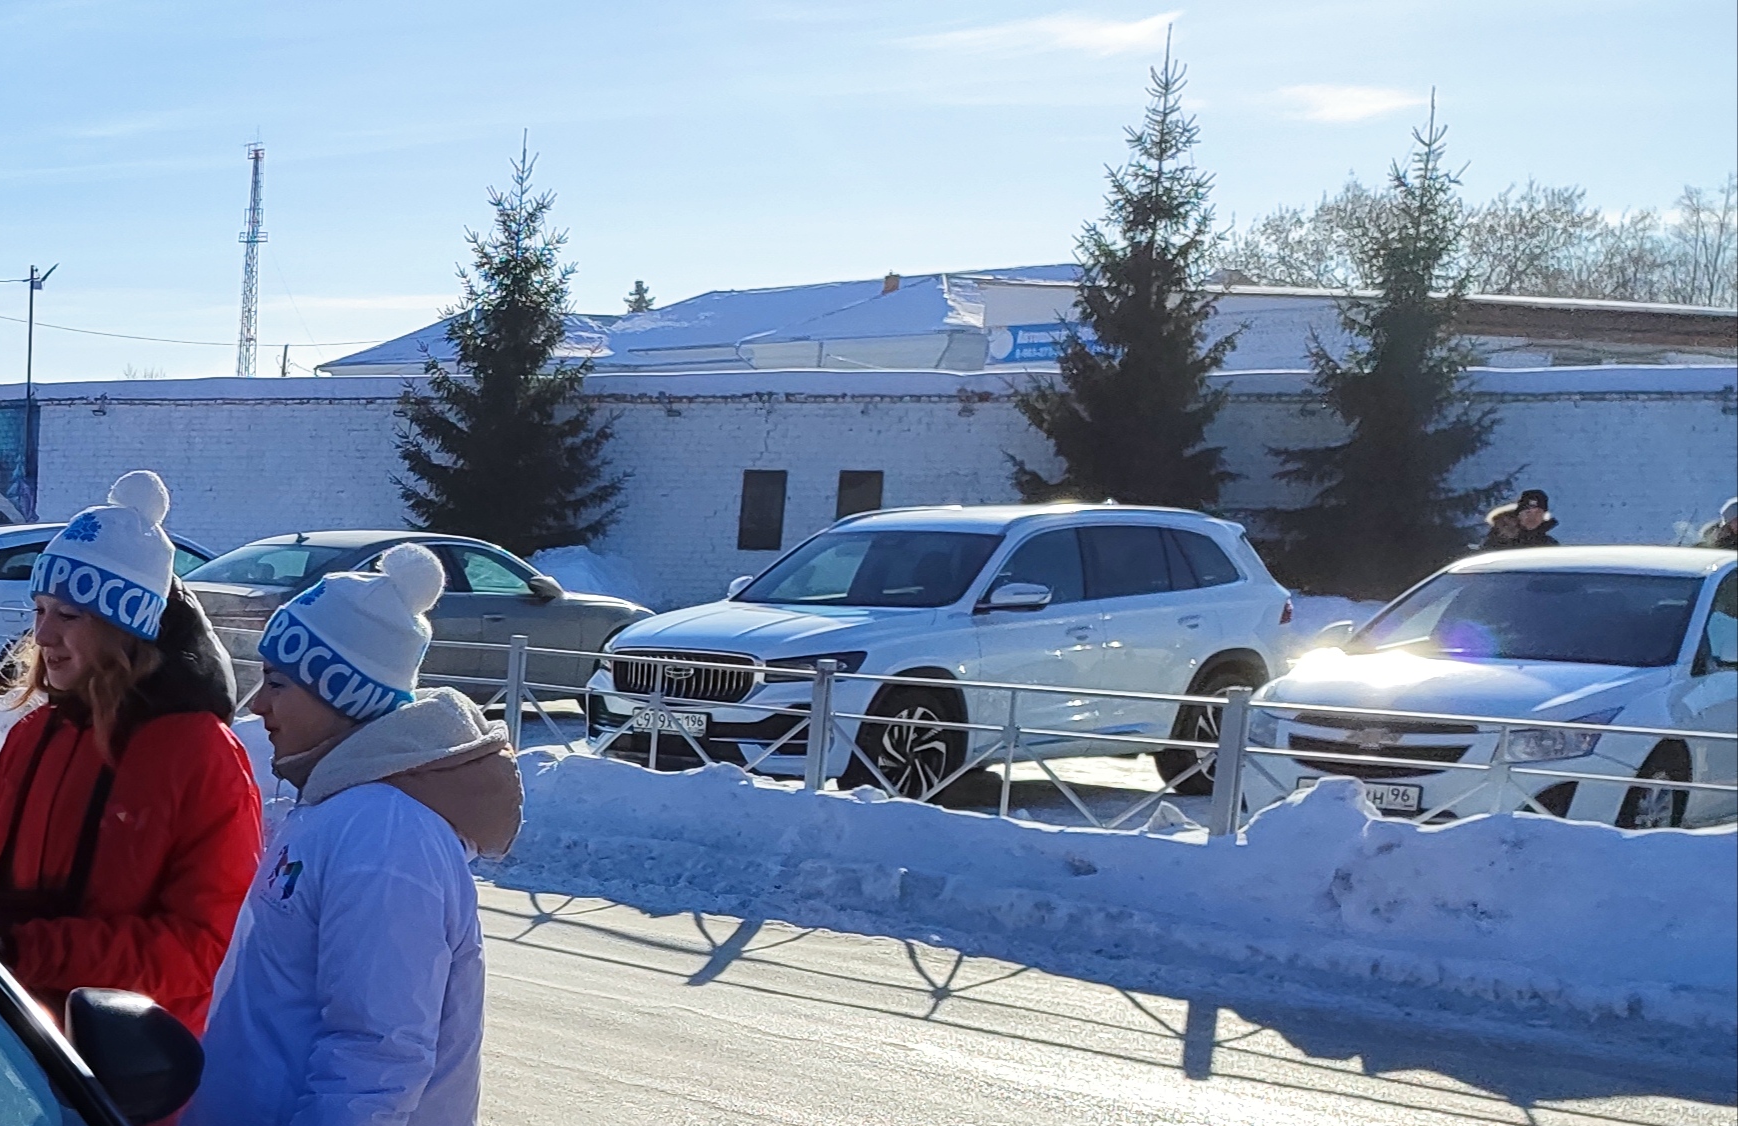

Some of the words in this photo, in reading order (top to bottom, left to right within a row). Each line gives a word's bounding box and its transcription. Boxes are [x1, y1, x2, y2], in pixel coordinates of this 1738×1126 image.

[262, 611, 395, 720] РОССИИ
[684, 714, 704, 728] 196
[1390, 787, 1411, 803] 96
